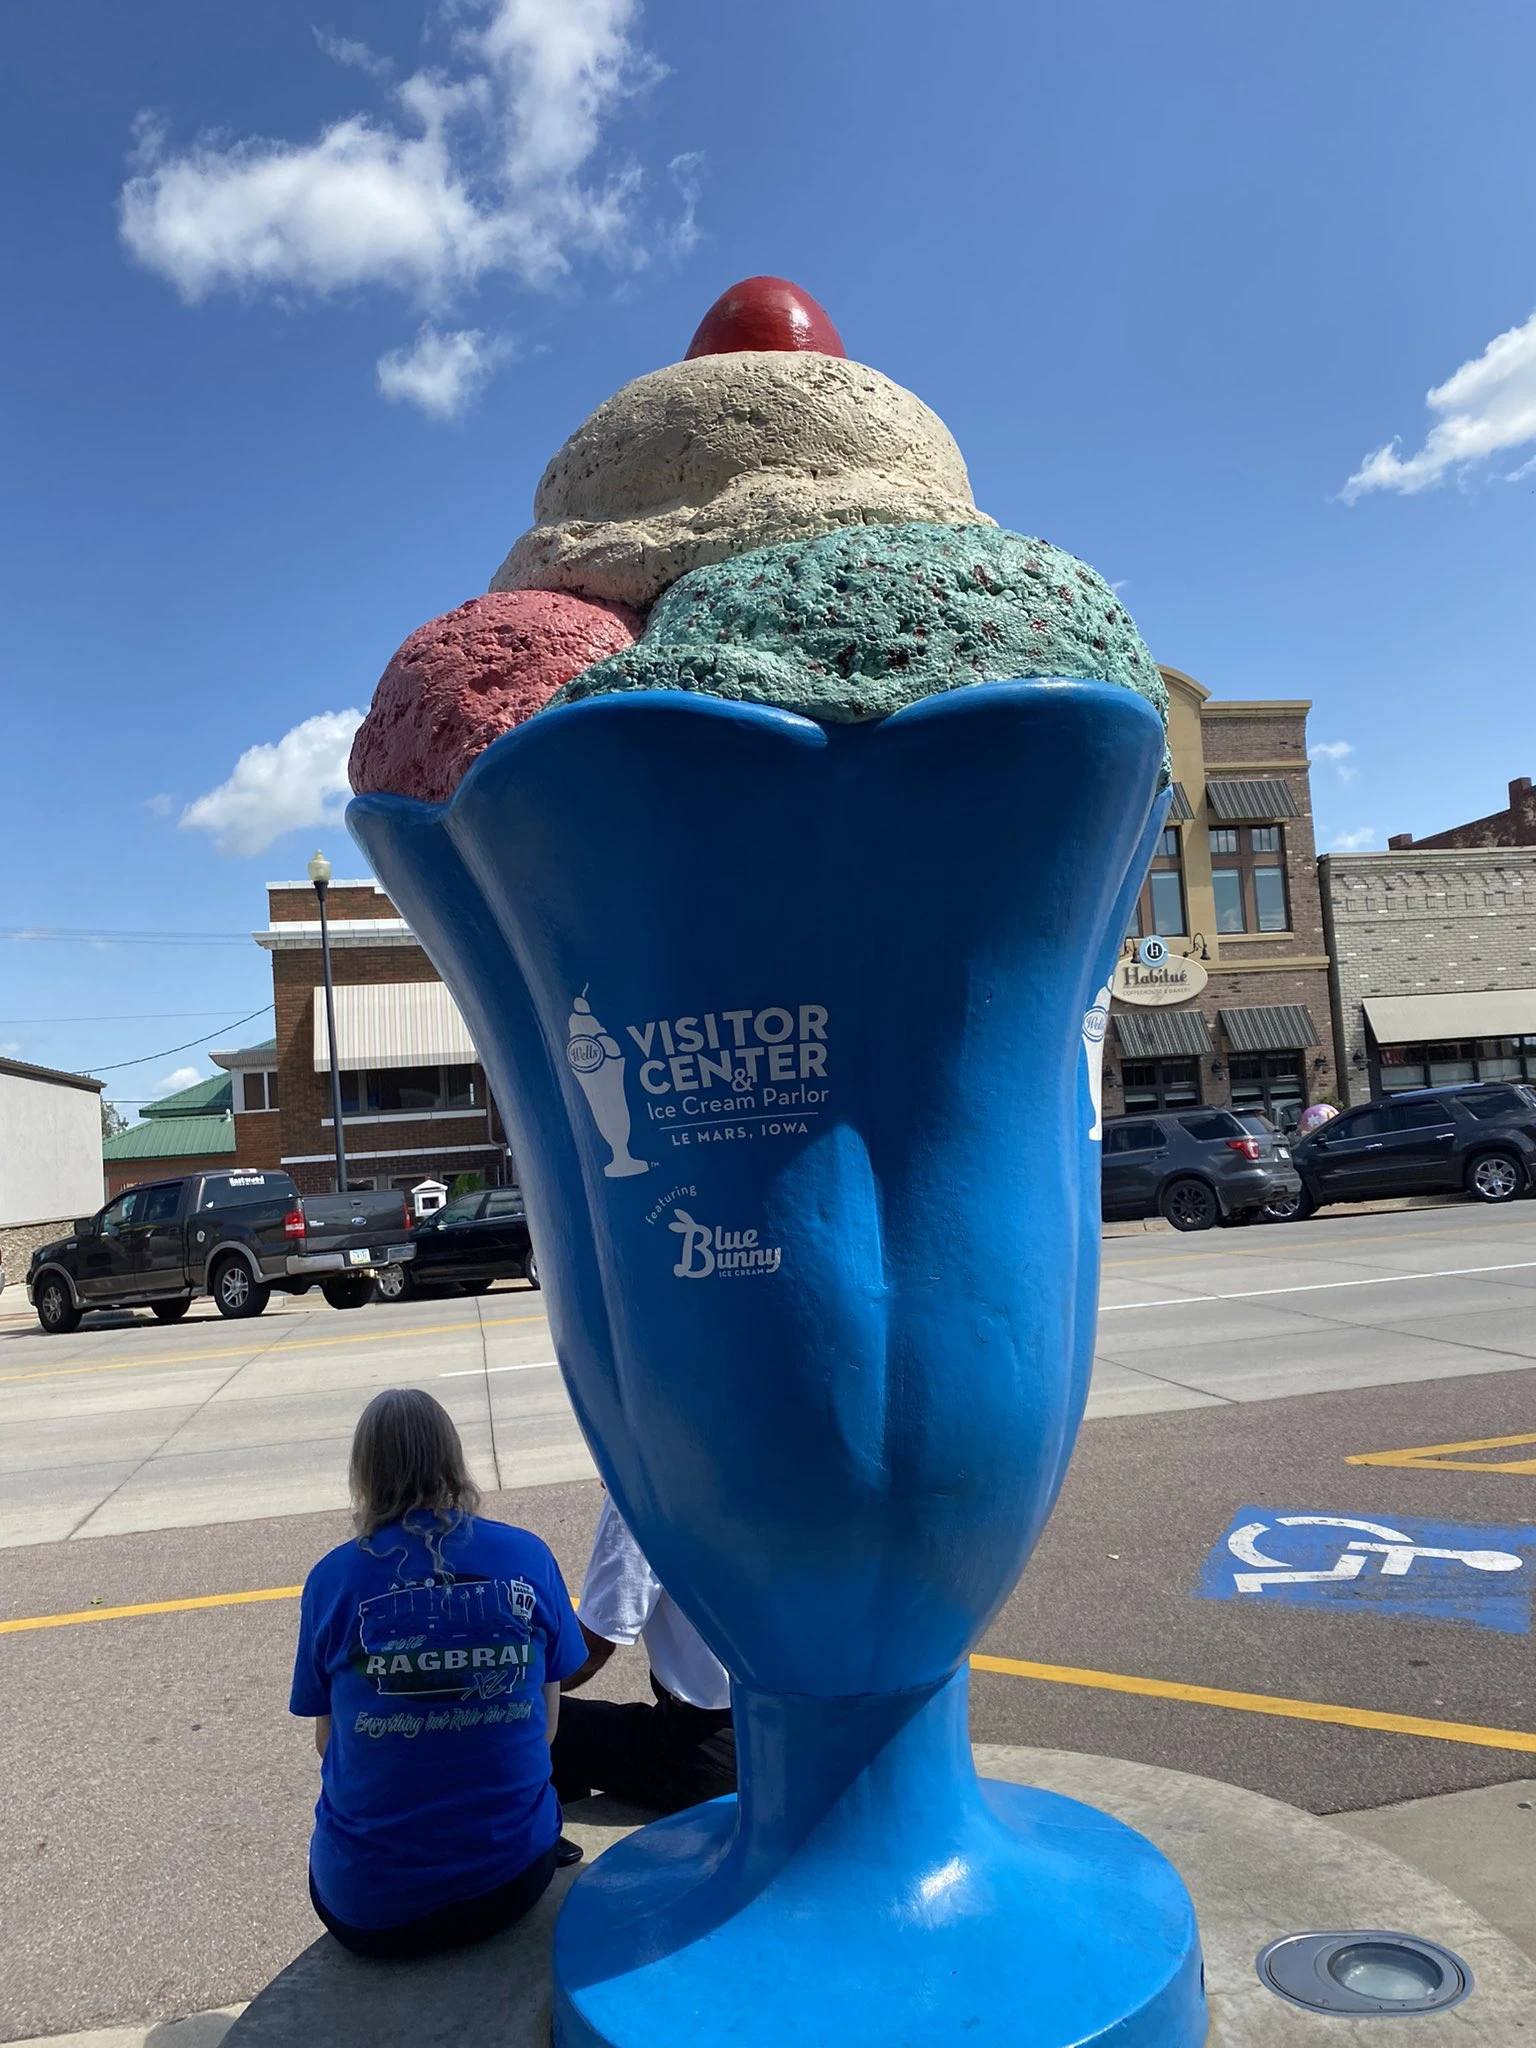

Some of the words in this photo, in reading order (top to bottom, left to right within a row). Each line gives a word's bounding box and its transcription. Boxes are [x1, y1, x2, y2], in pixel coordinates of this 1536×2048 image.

[1122, 966, 1188, 986] Habitué
[626, 1004, 829, 1059] VISITOR
[570, 1044, 598, 1062] Wells
[639, 1042, 829, 1095] CENTER
[731, 1068, 754, 1092] &
[647, 1102, 676, 1121] Ice
[682, 1096, 756, 1115] Cream
[763, 1084, 829, 1107] Parlor
[671, 1133, 691, 1146] LE
[697, 1126, 753, 1143] MARS,
[762, 1122, 808, 1136] IOWA
[645, 1185, 697, 1225] featuring
[668, 1209, 759, 1278] Blue
[719, 1269, 732, 1278] ICE
[735, 1268, 764, 1277] CREAM
[516, 1594, 534, 1610] 40
[381, 1635, 427, 1652] 2012
[366, 1645, 529, 1675] RAGBRAI
[354, 1711, 424, 1738] Everything
